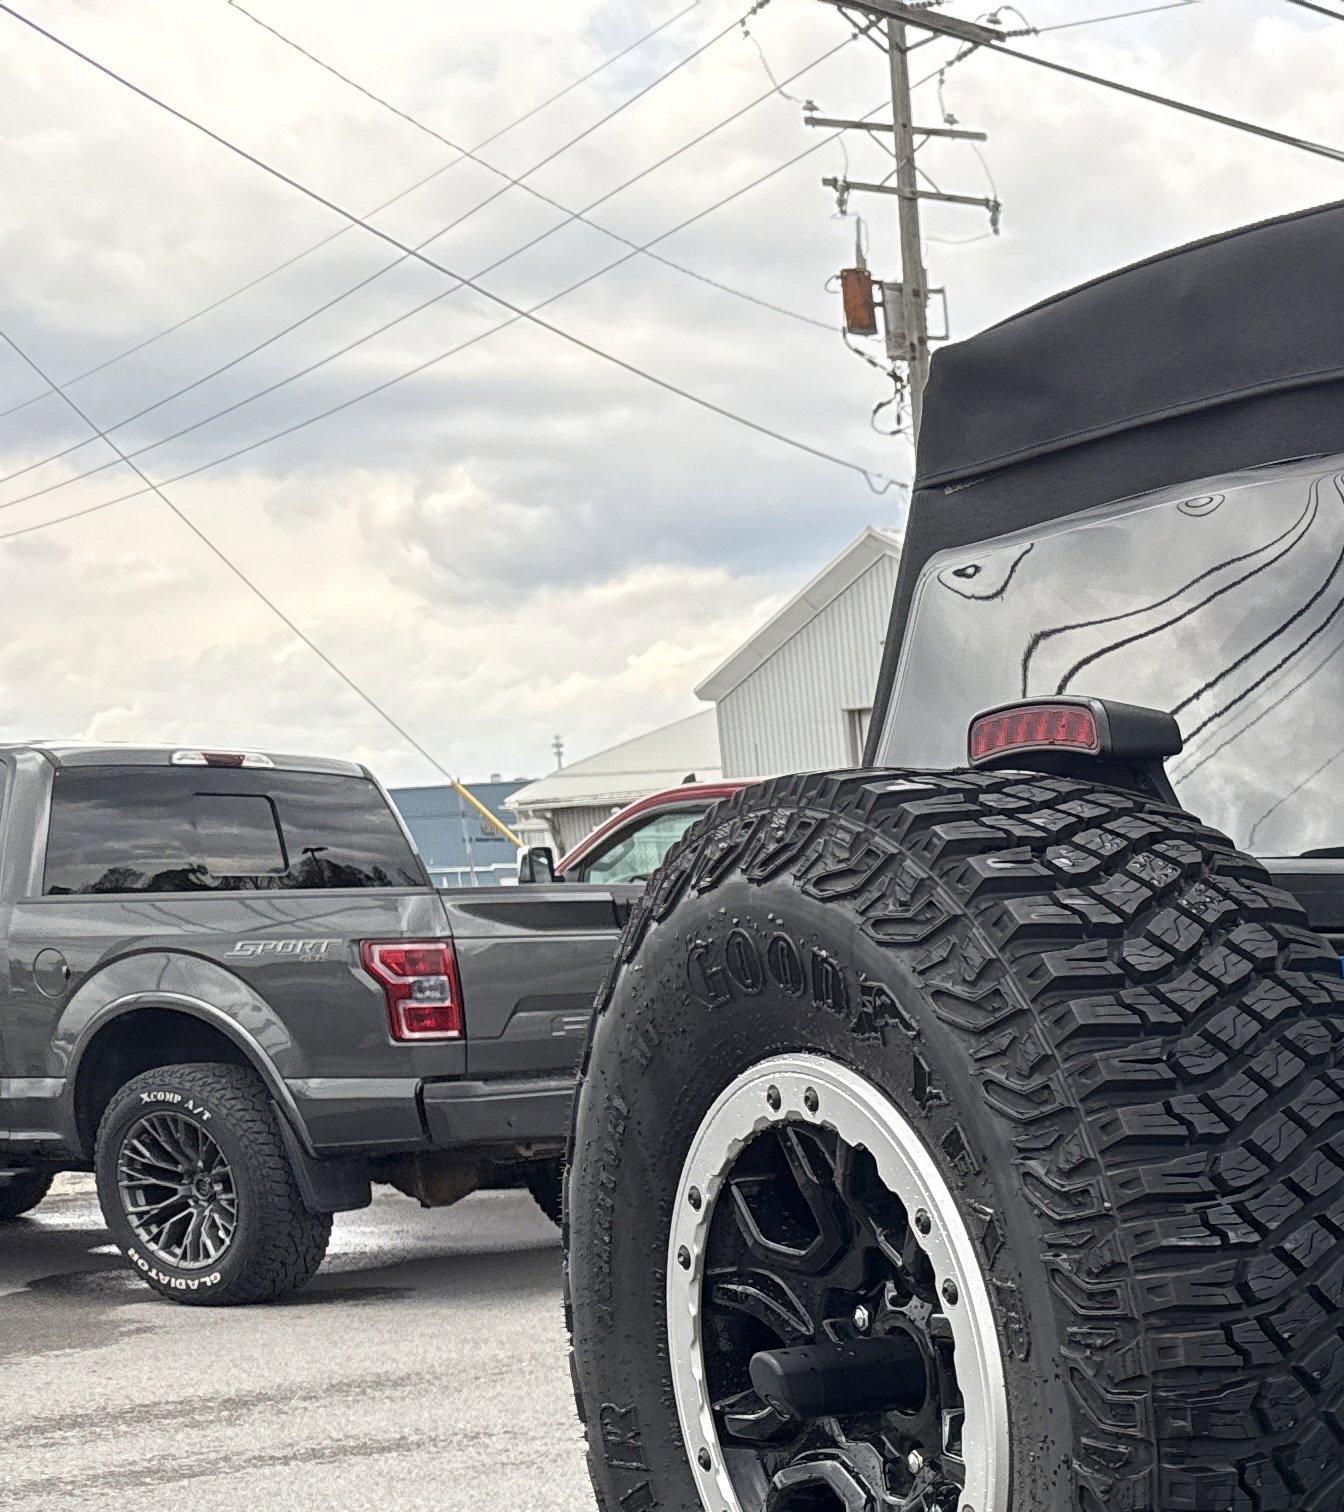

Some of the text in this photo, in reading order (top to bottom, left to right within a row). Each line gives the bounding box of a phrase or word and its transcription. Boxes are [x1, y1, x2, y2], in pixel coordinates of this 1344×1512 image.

[223, 938, 343, 959] SPORT
[140, 1091, 212, 1121] XCOMP A/T
[127, 1247, 222, 1290] GLADIATOR
